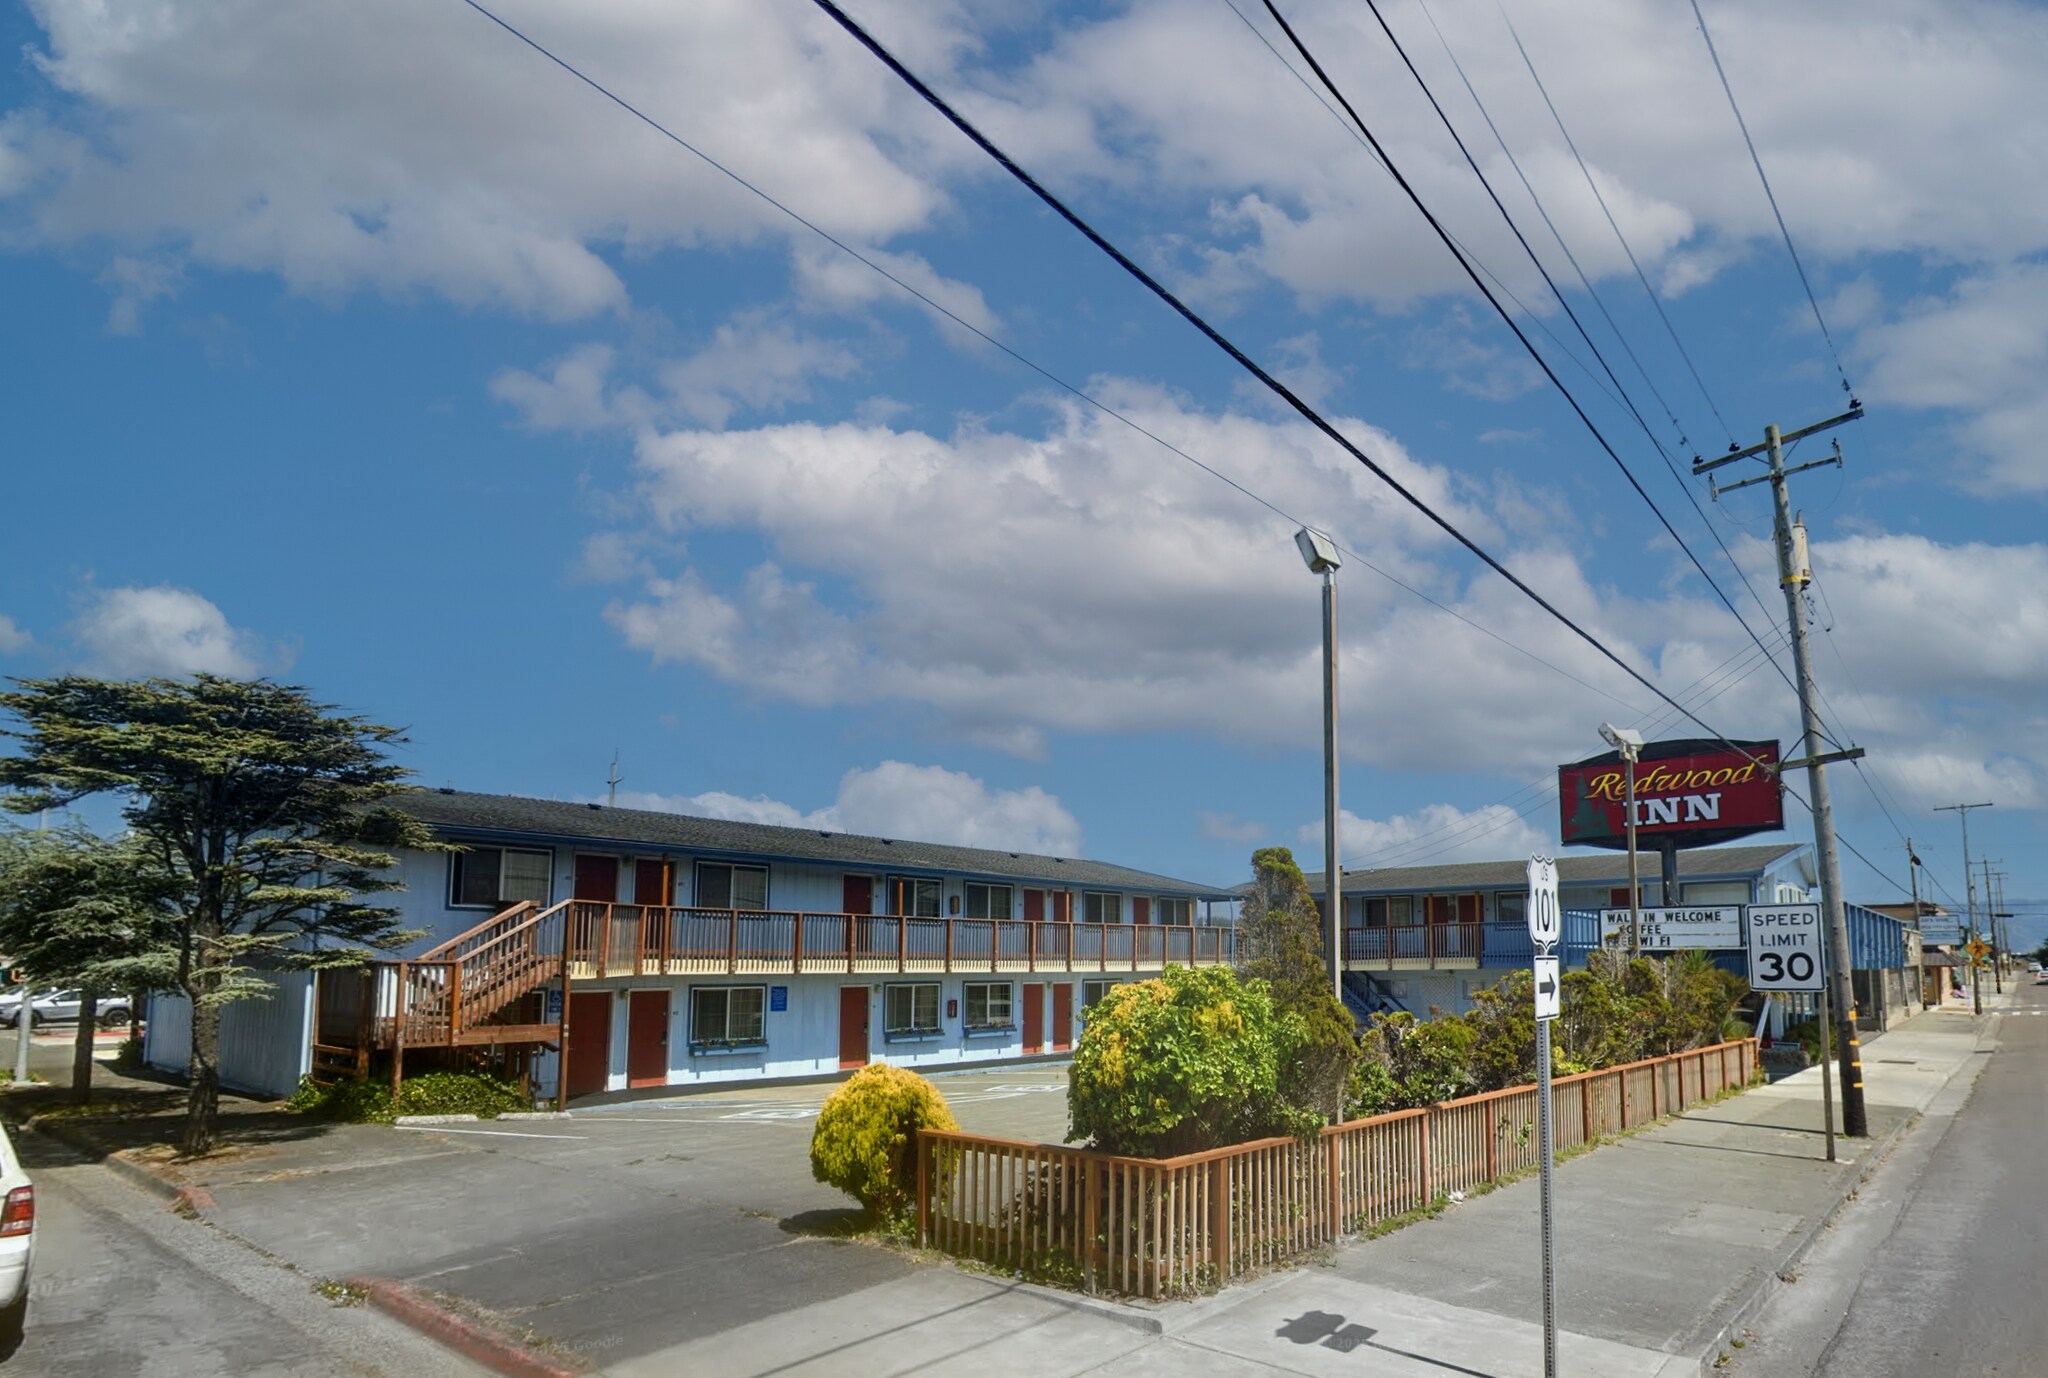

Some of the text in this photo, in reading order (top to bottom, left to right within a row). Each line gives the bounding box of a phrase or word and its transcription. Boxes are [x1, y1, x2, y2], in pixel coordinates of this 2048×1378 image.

[1584, 754, 1768, 801] Redwood
[1623, 793, 1721, 827] INN
[1534, 887, 1556, 932] 101
[1607, 911, 1721, 923] WAL IN WELCOME
[1753, 913, 1814, 926] SPEED
[1621, 924, 1661, 934] OFEE
[1640, 936, 1653, 946] WI
[1660, 936, 1671, 946] FI
[1760, 933, 1807, 946] LIMIT
[1759, 952, 1814, 981] 30
